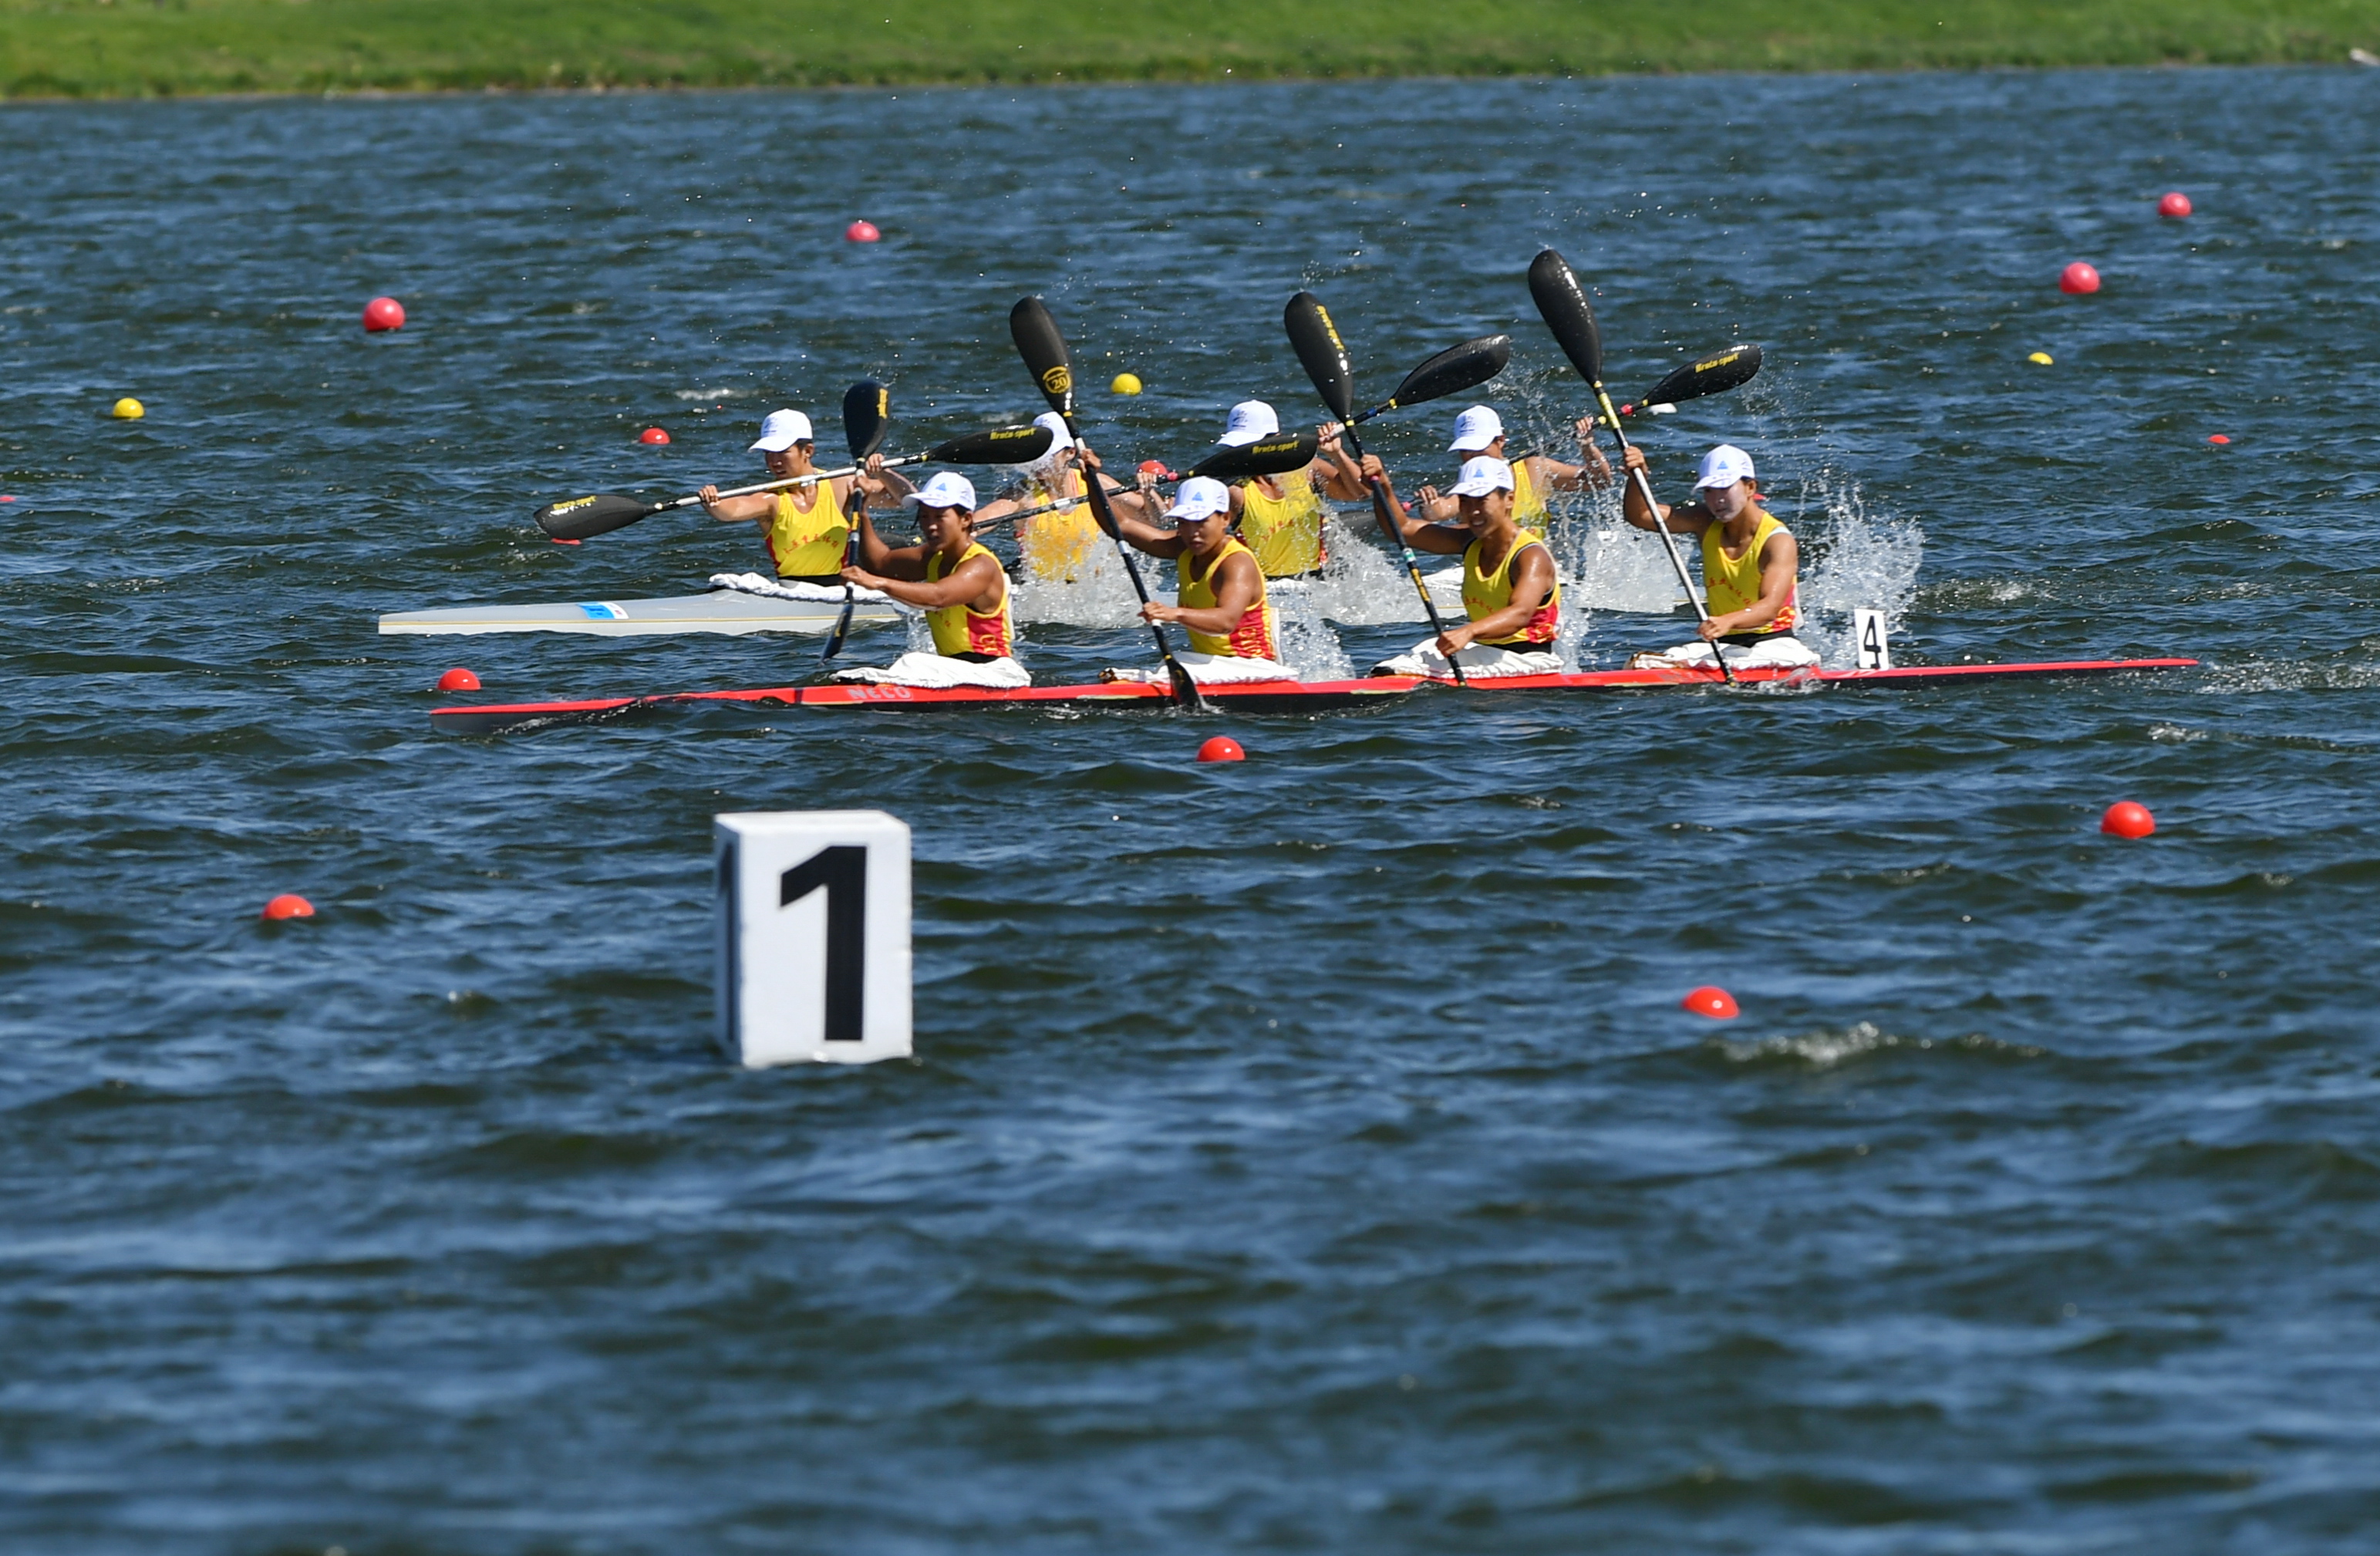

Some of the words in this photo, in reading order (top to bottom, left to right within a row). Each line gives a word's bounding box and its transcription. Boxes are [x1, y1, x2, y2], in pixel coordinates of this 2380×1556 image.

[1051, 376, 1067, 390] 20
[1863, 615, 1883, 669] 4
[780, 846, 868, 1041] 1
